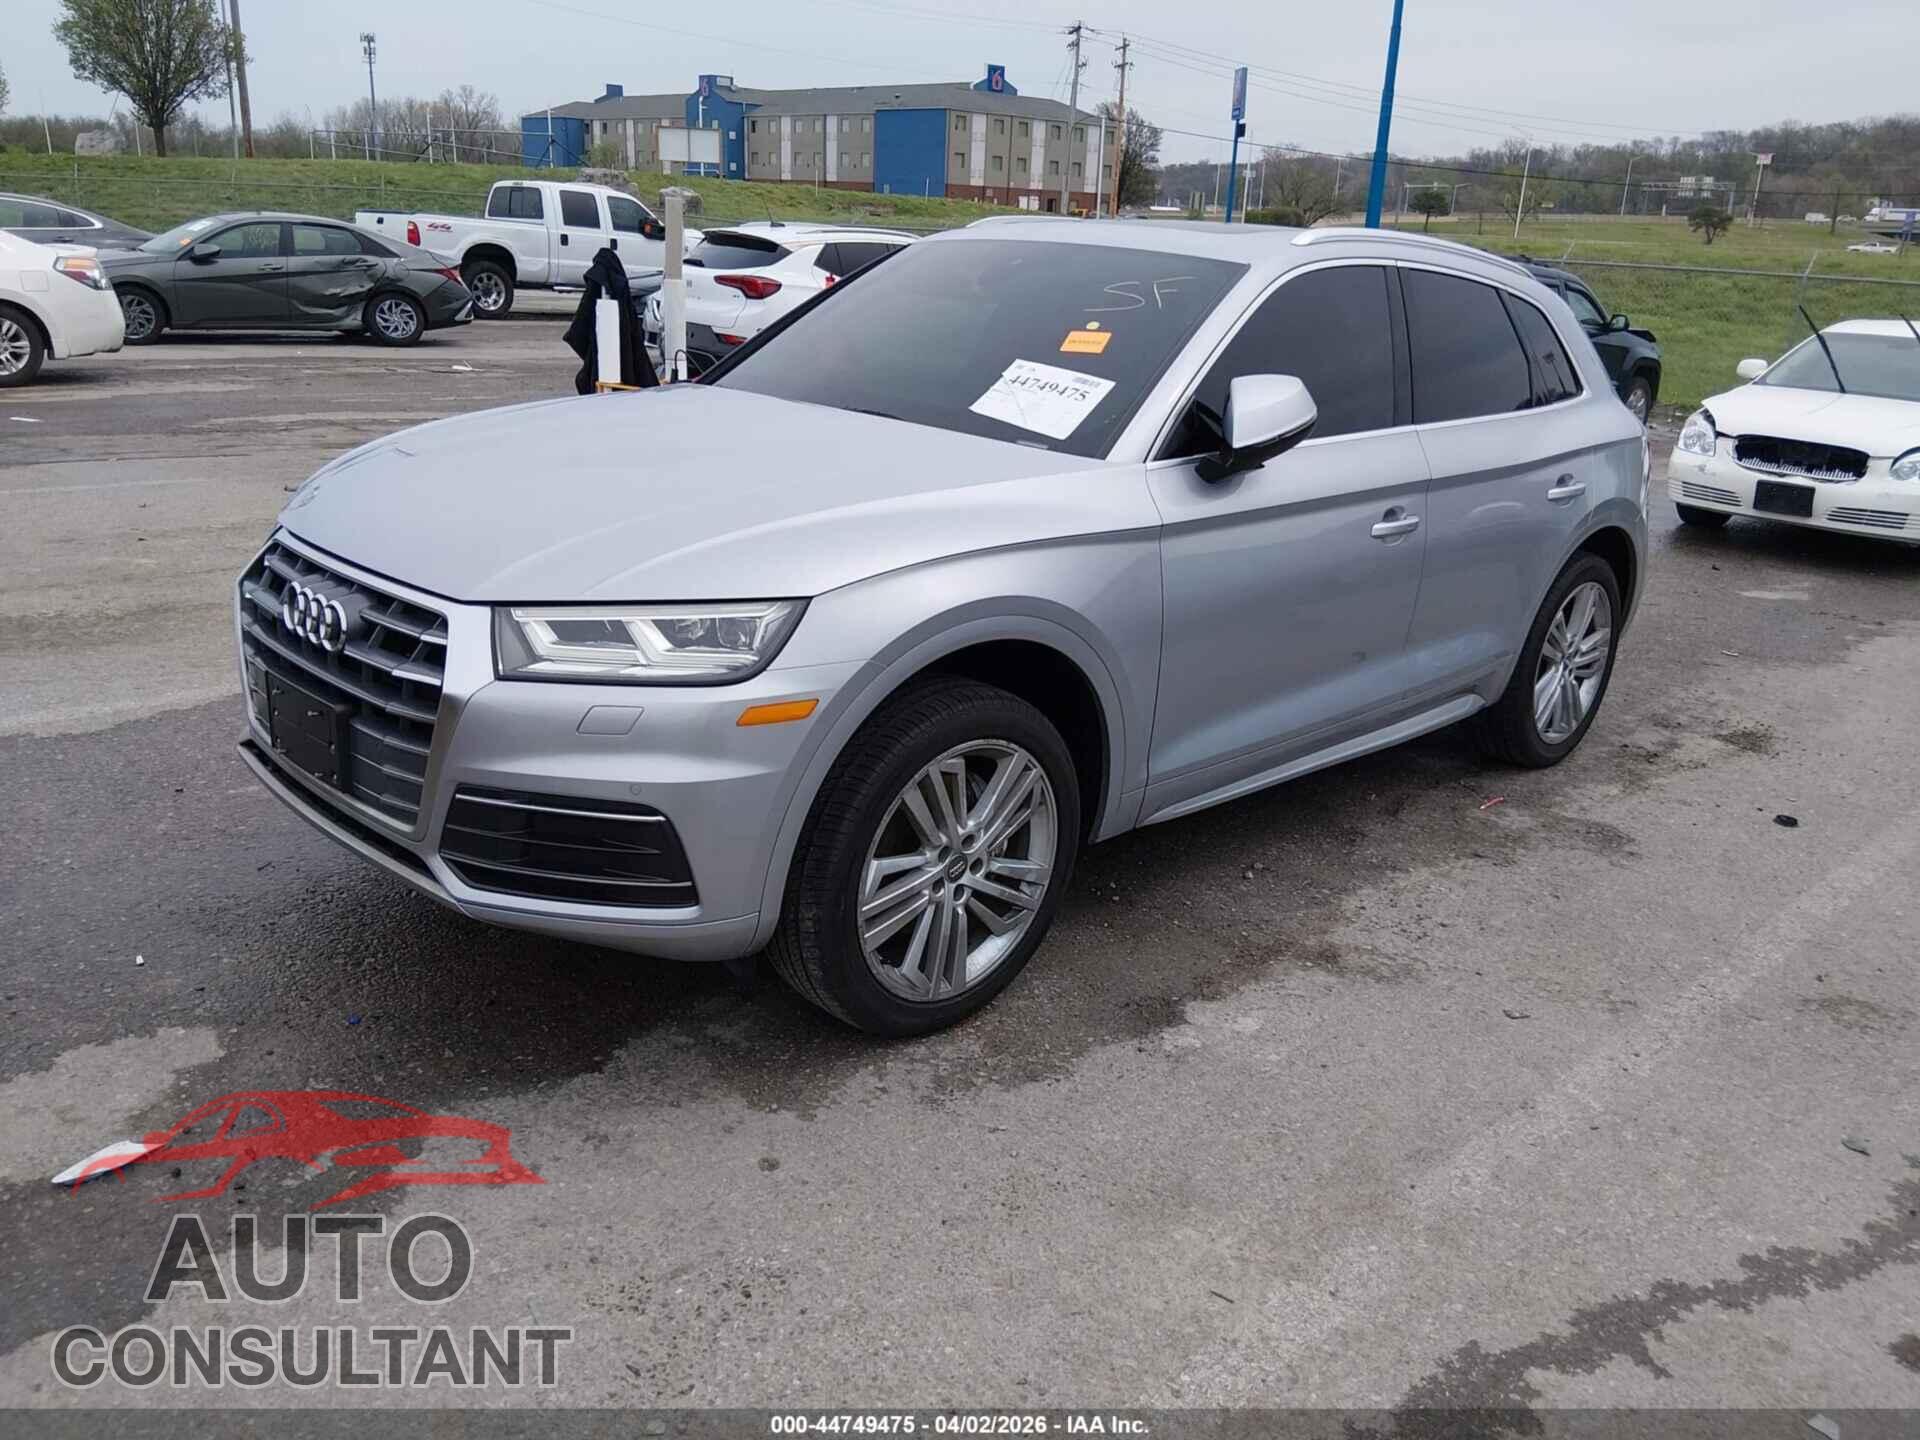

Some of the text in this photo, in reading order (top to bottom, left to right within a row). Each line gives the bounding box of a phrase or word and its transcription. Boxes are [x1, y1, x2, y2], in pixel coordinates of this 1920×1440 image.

[700, 77, 710, 97] 6
[992, 70, 1003, 91] 6
[1082, 275, 1200, 312] SF
[1008, 375, 1091, 402] 44749475
